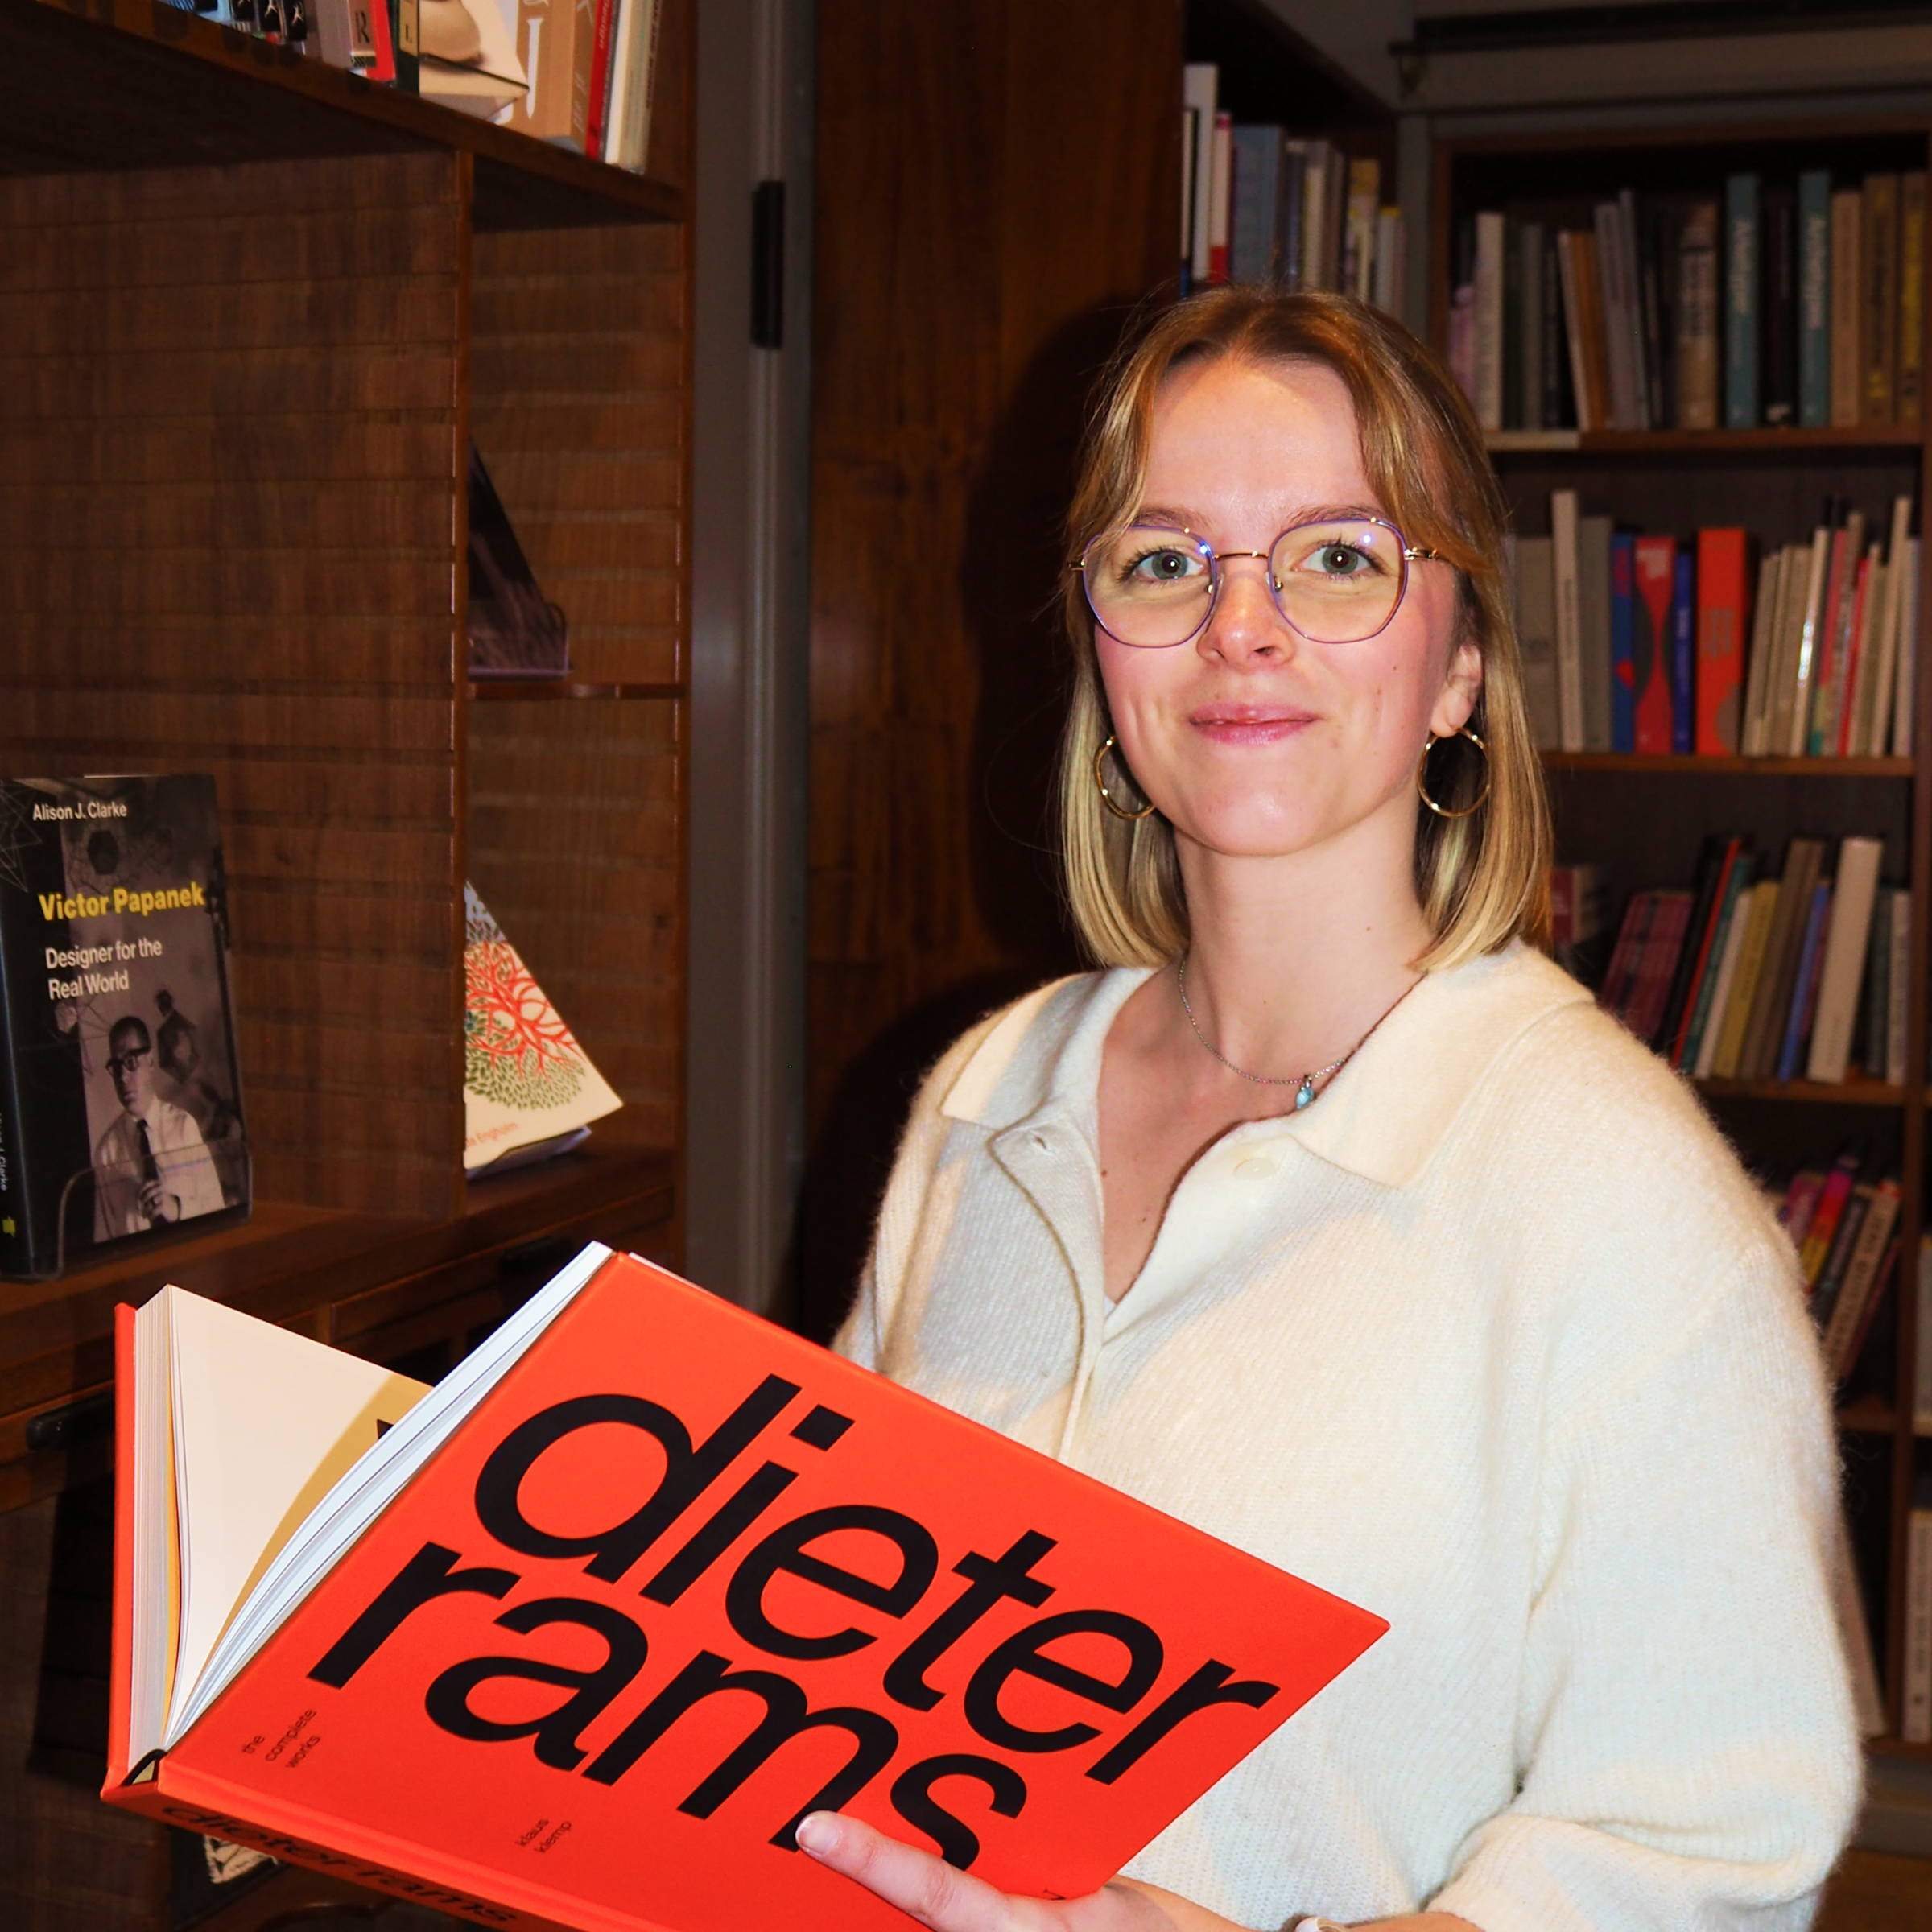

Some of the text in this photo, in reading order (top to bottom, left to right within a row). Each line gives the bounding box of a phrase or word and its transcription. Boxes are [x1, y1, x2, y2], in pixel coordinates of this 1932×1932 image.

[33, 801, 128, 821] Alison J. Clarke
[39, 881, 205, 921] Victor Papanek
[45, 937, 163, 969] Designer for the
[48, 969, 130, 1001] Real World
[475, 1373, 1281, 1785] dieter
[307, 1541, 1027, 1872] rams
[242, 1735, 265, 1754] the
[265, 1709, 316, 1761] complete
[285, 1735, 321, 1768] works
[514, 1819, 549, 1847] klaus
[534, 1821, 572, 1853] klemp
[163, 1806, 517, 1922] dieter rams
